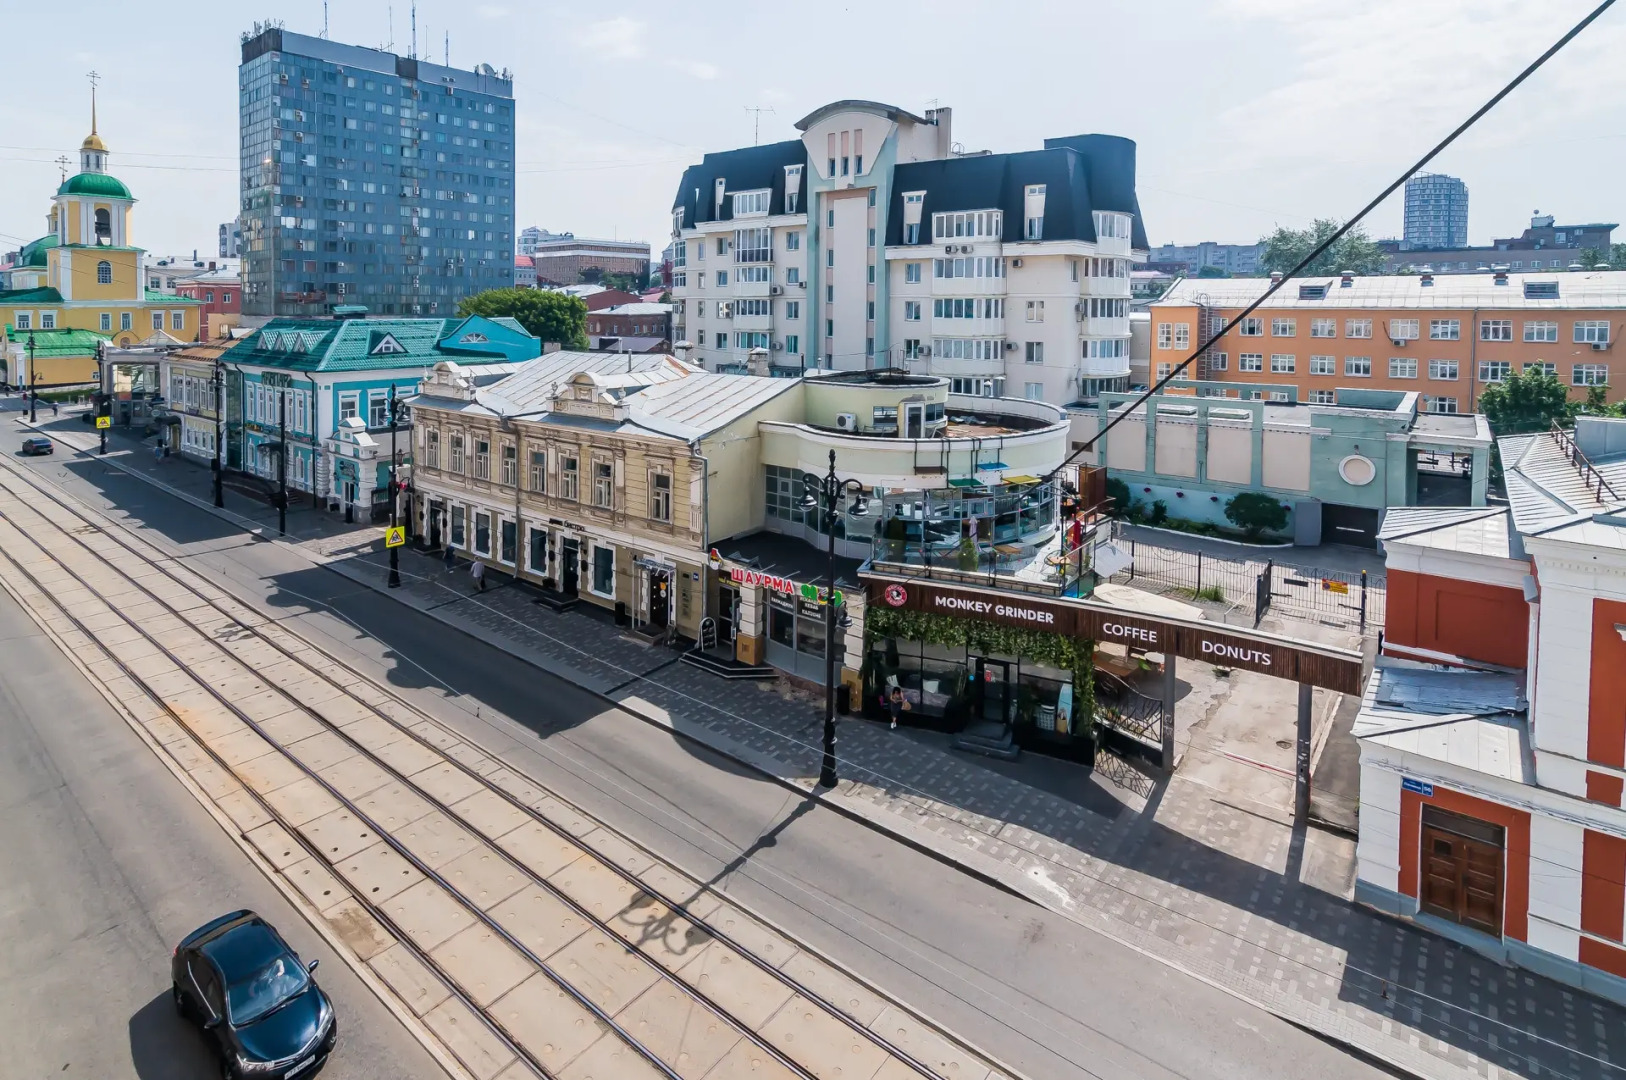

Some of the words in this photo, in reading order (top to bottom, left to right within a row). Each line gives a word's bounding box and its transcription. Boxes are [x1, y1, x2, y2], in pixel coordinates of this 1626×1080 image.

[731, 567, 795, 595] ШАУРМА
[935, 595, 993, 614] MONKEY
[994, 604, 1054, 624] GRINDER
[1102, 622, 1158, 643] COFFEE
[1201, 640, 1272, 666] DONUTS
